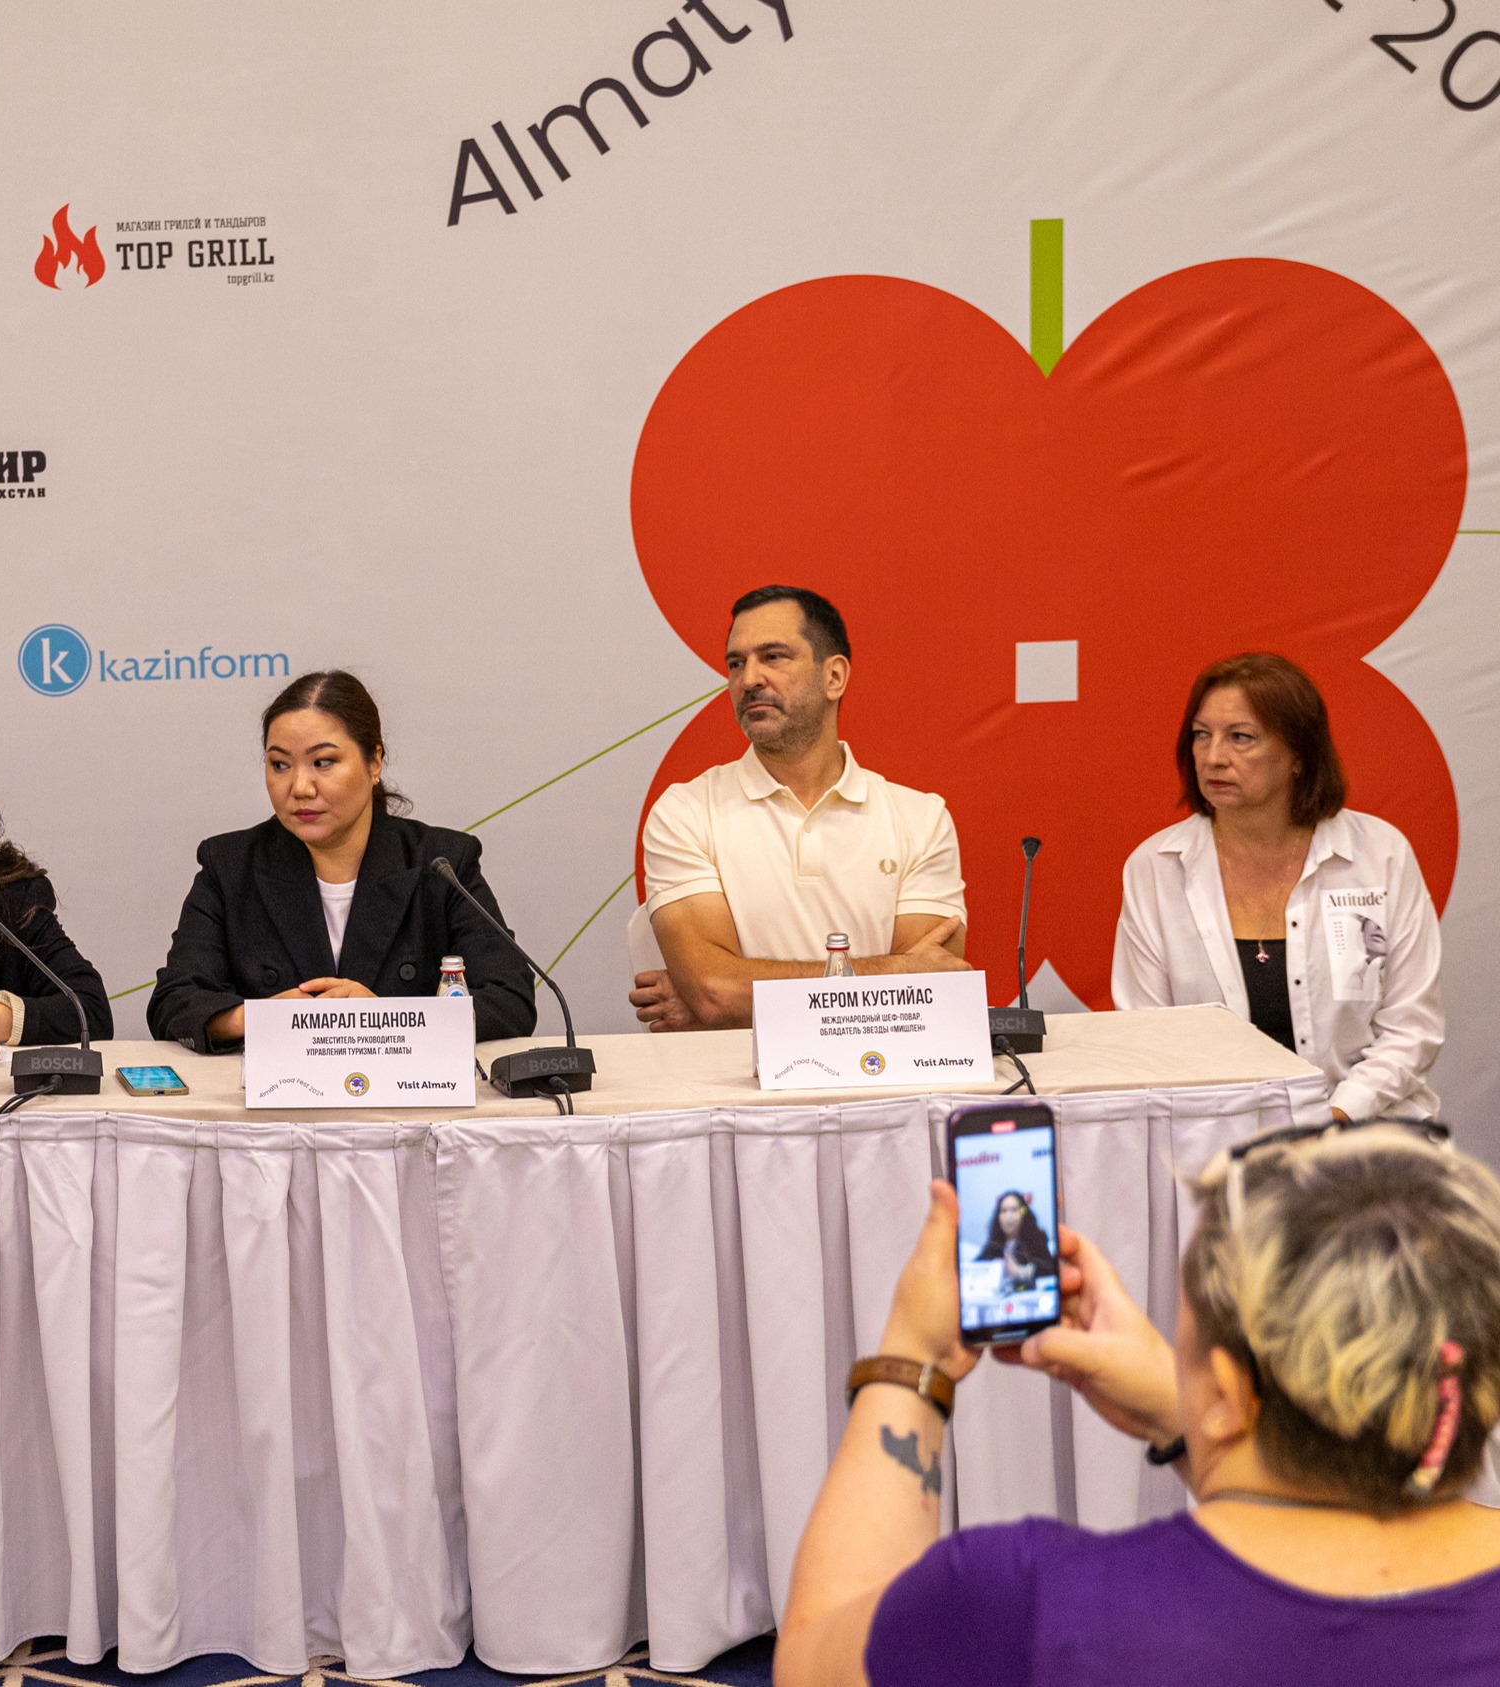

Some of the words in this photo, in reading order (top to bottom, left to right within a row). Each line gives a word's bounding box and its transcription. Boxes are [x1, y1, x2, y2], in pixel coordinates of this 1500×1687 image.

[116, 221, 161, 232] МАГАЗИН
[164, 217, 201, 231] ГРИЛЕЙ
[204, 219, 211, 229] И
[214, 216, 266, 229] ТАНДЫРОВ
[116, 242, 173, 270] TOP
[188, 238, 275, 268] GRILL
[227, 272, 275, 286] topgrill.kz
[99, 646, 290, 682] kazinform
[808, 991, 859, 1009] ЖЕРОМ
[862, 985, 933, 1007] КУСТИЙАС
[291, 1012, 355, 1030] АКМАРАЛ
[360, 1011, 426, 1030] ЕЩАНОВА
[821, 1013, 881, 1025] МЕЖДУНАРОДНЫЙ
[989, 1016, 1027, 1030] SCH
[820, 1027, 862, 1037] ОБЛАДАТЕЛЬ
[862, 1025, 889, 1035] ЗВЕЗДЫ
[890, 1023, 926, 1033] «МИШЛЕН»
[312, 1036, 356, 1045] ЗАМЕСТИТЕЛЬ
[357, 1035, 406, 1044] РУКОВОДИТЕЛЯ
[306, 1048, 347, 1057] УПРАВЛЕНИЯ
[347, 1047, 376, 1056] ТУРИЗМА
[377, 1047, 384, 1055] Г.
[384, 1046, 412, 1055] АЛМАТЫ
[30, 1057, 84, 1070] BOSCH
[528, 1056, 579, 1072] BOSCH
[913, 1058, 937, 1068] Visit
[938, 1057, 974, 1067] Almaty
[397, 1081, 420, 1090] Visit
[421, 1081, 457, 1091] Almaty
